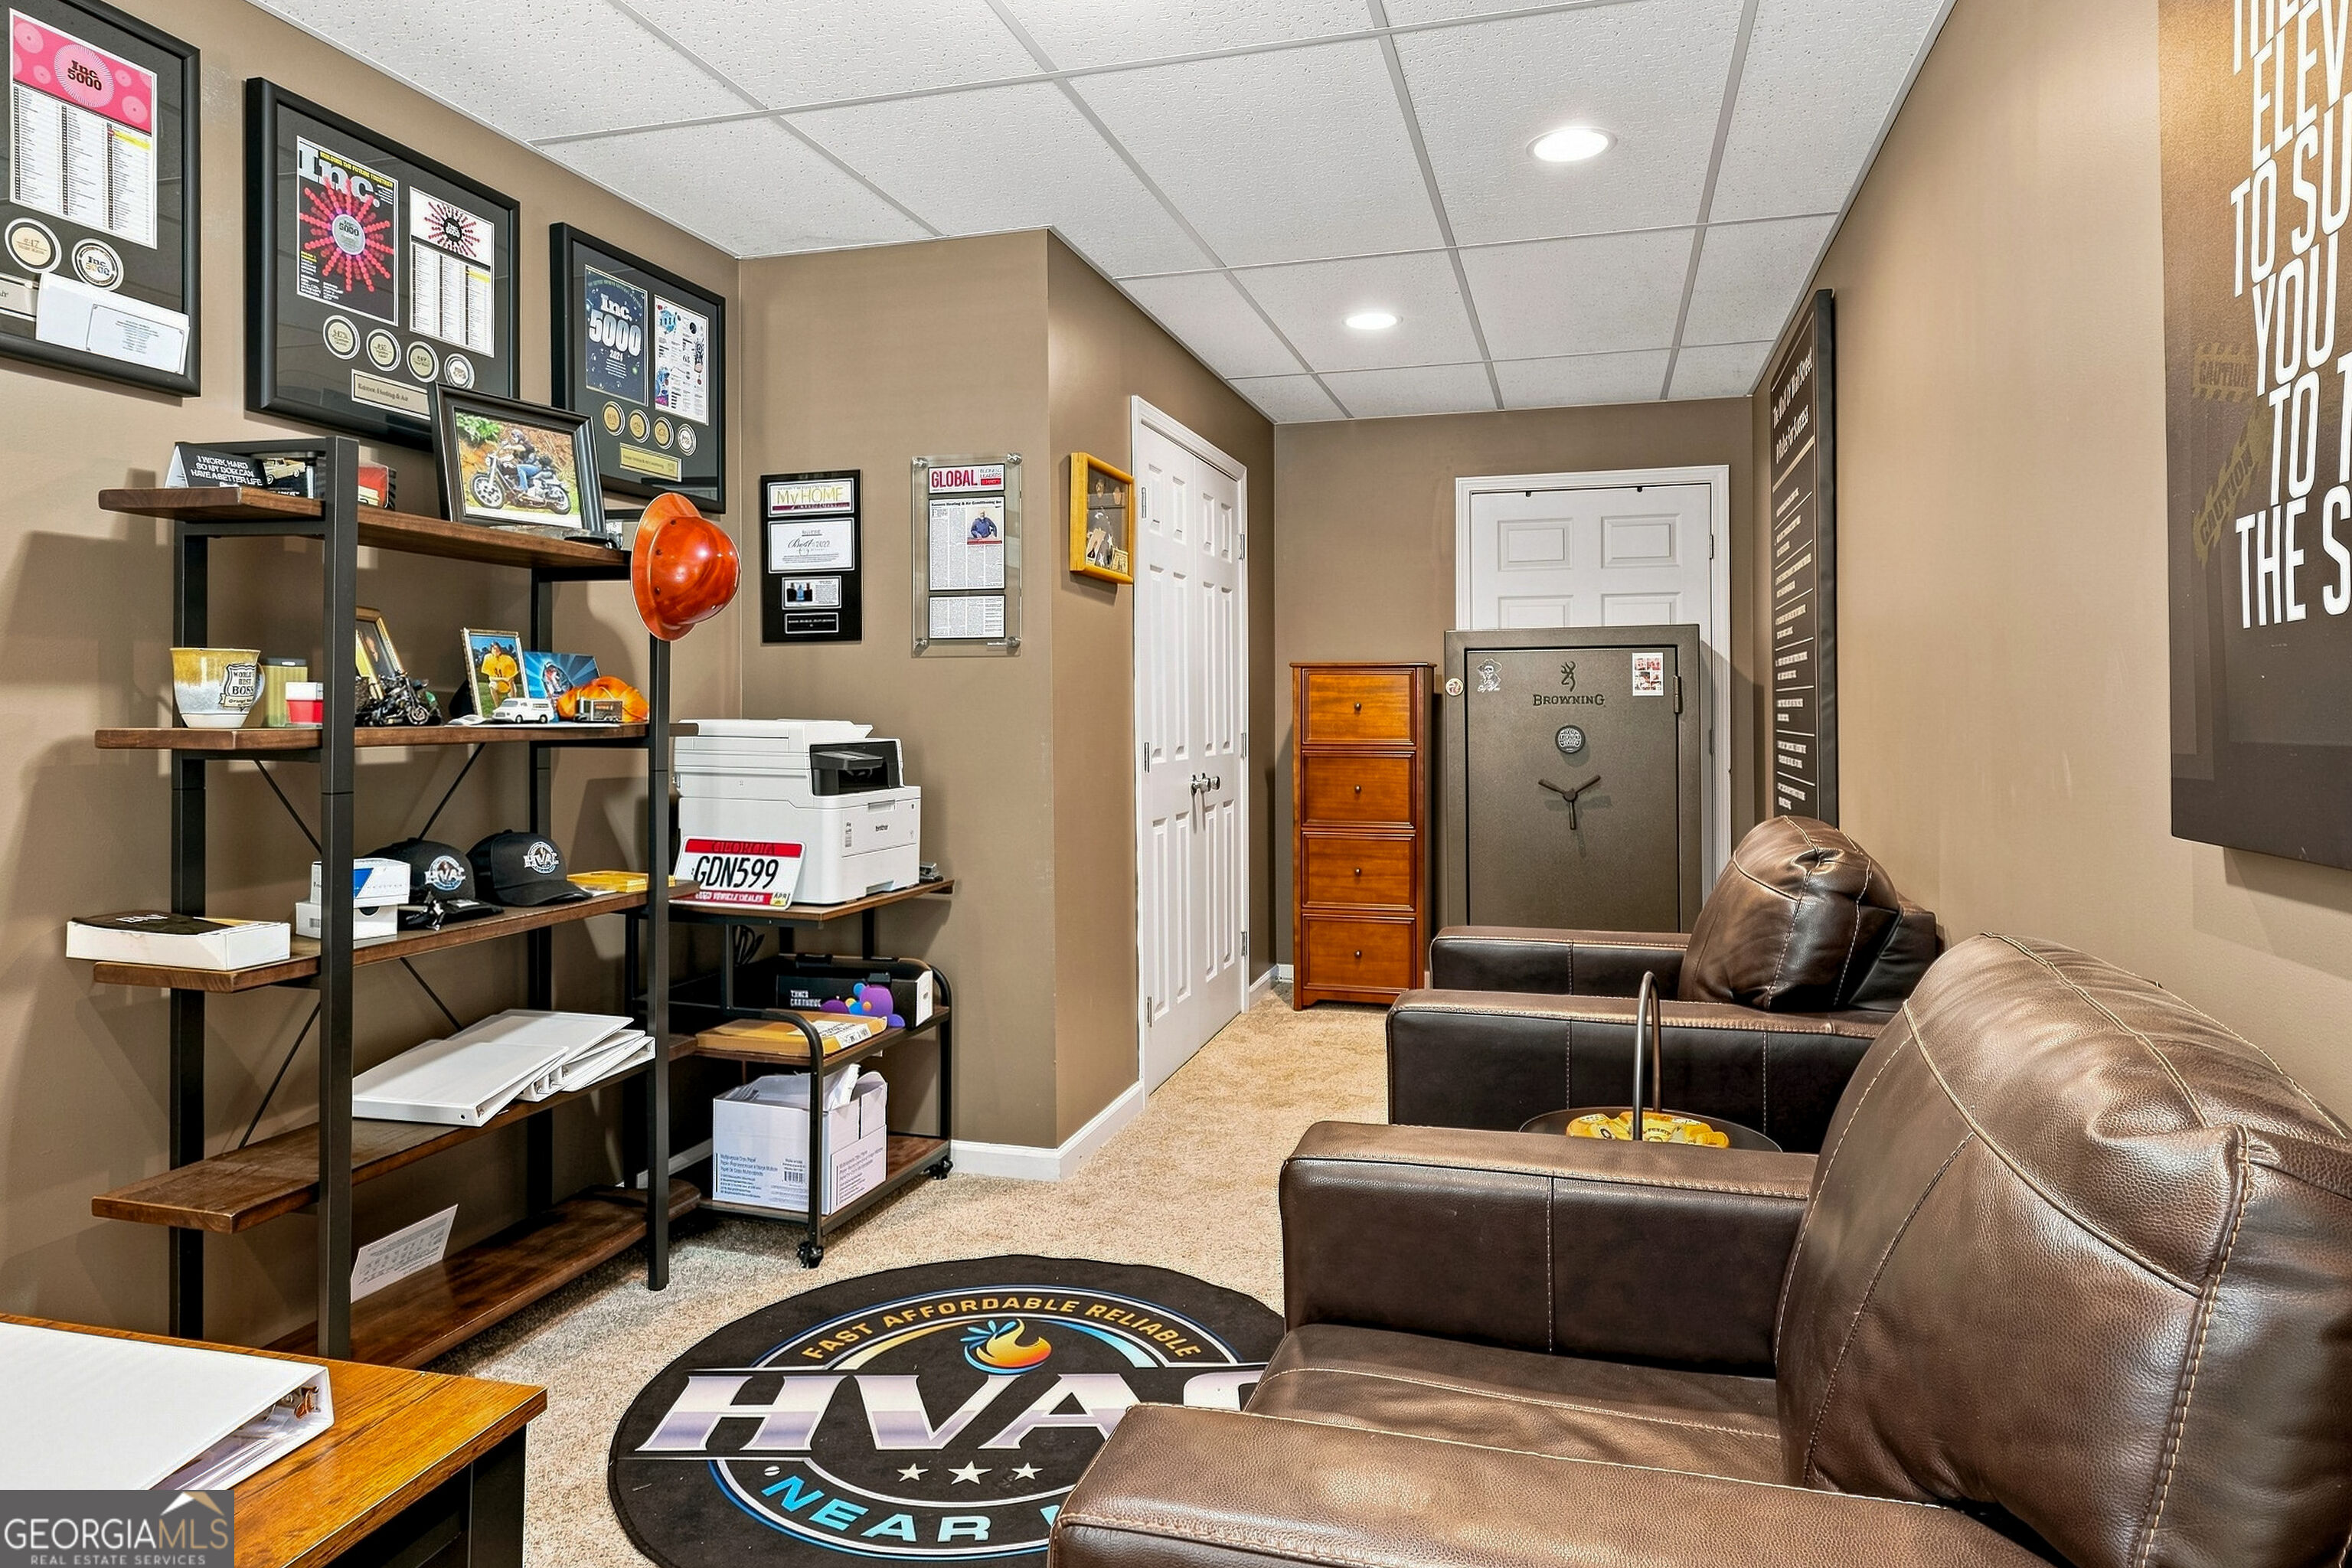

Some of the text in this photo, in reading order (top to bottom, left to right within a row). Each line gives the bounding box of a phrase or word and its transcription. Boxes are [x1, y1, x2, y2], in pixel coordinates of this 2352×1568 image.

[67, 67, 102, 90] 5000
[2230, 92, 2352, 298] TO SU
[600, 293, 632, 322] Inc.
[2252, 230, 2338, 397] YOU
[589, 309, 642, 357] 5000
[2269, 371, 2321, 506] TO
[191, 469, 212, 479] HAVE
[217, 473, 247, 484] BETTER
[246, 477, 263, 486] LIFE
[196, 462, 207, 471] SO
[239, 469, 255, 478] CAN
[227, 460, 248, 469] HARD
[931, 469, 978, 488] GLOBAL
[2236, 497, 2307, 629] THE
[1533, 694, 1605, 706] BROWNING
[523, 852, 560, 868] HVAC
[694, 855, 779, 889] GDN599
[424, 866, 467, 885] HVAC
[713, 892, 738, 901] VEHICLE
[738, 893, 764, 903] DEALER
[802, 1297, 1201, 1359] FAST AFFORDABLE RELIABLE
[761, 1475, 992, 1544] NEAR
